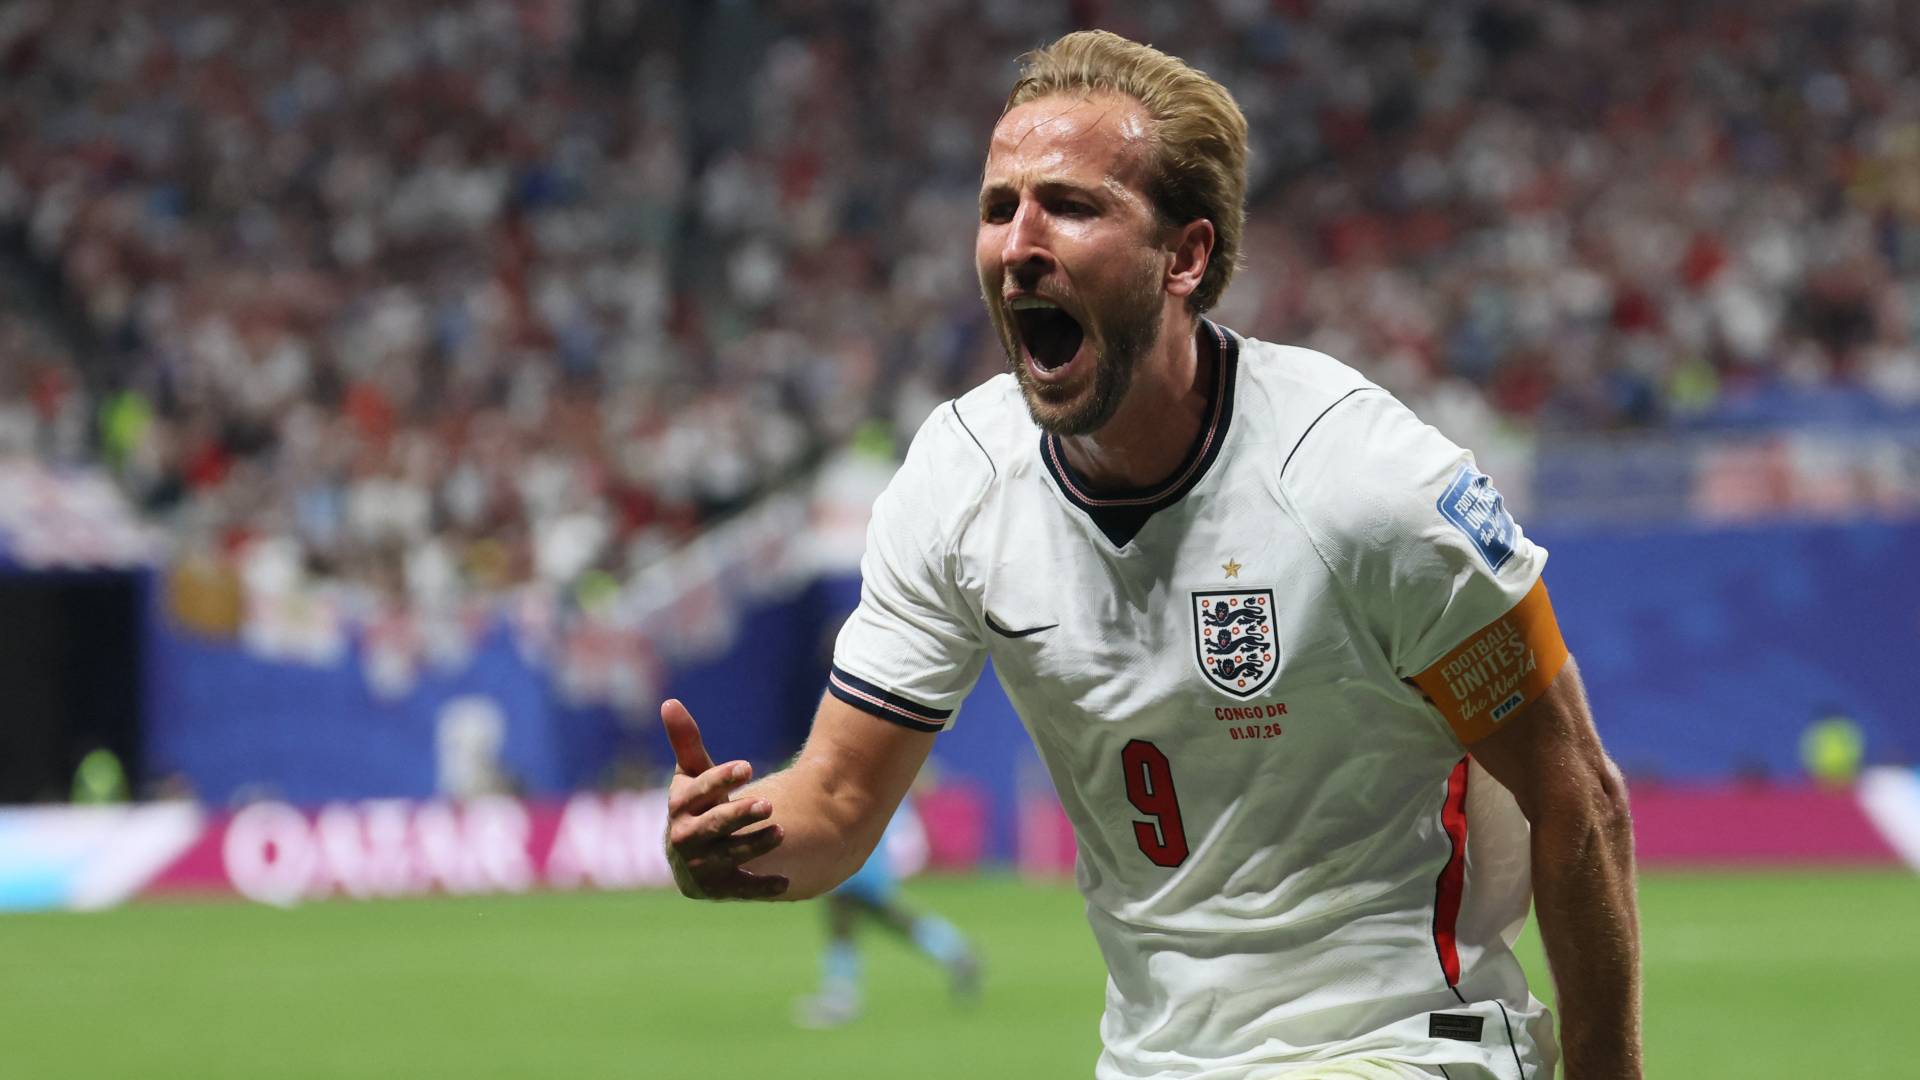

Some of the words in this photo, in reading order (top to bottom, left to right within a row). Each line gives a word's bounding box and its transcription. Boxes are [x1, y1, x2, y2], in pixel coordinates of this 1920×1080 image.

[1440, 620, 1517, 682] FOOTBALL
[1450, 632, 1525, 700] UNITES
[1215, 706, 1263, 721] CONGO
[1265, 702, 1288, 718] DR
[1457, 697, 1488, 721] the
[1488, 649, 1537, 700] World
[1491, 693, 1523, 720] FIFA
[1229, 723, 1282, 740] 01.07.26
[1121, 738, 1189, 868] 9
